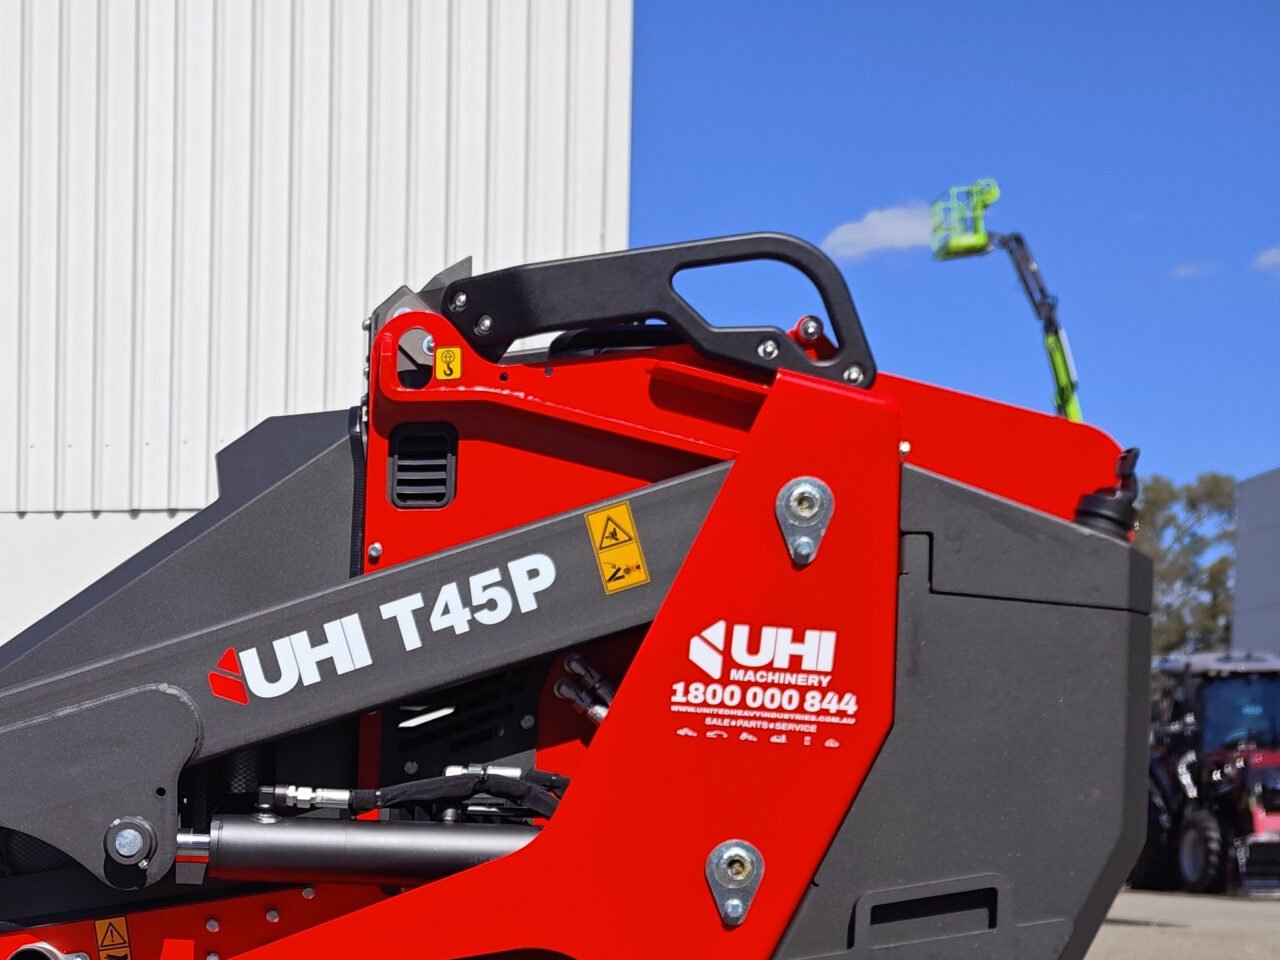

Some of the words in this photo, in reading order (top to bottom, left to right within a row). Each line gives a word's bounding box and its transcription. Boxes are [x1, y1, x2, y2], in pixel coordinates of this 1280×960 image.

[238, 613, 373, 698] UHI
[378, 553, 556, 652] T45P
[730, 624, 837, 672] UHI
[671, 681, 742, 707] 1800
[745, 686, 800, 711] 000
[803, 690, 858, 715] 844
[730, 668, 832, 687] MACHINERY
